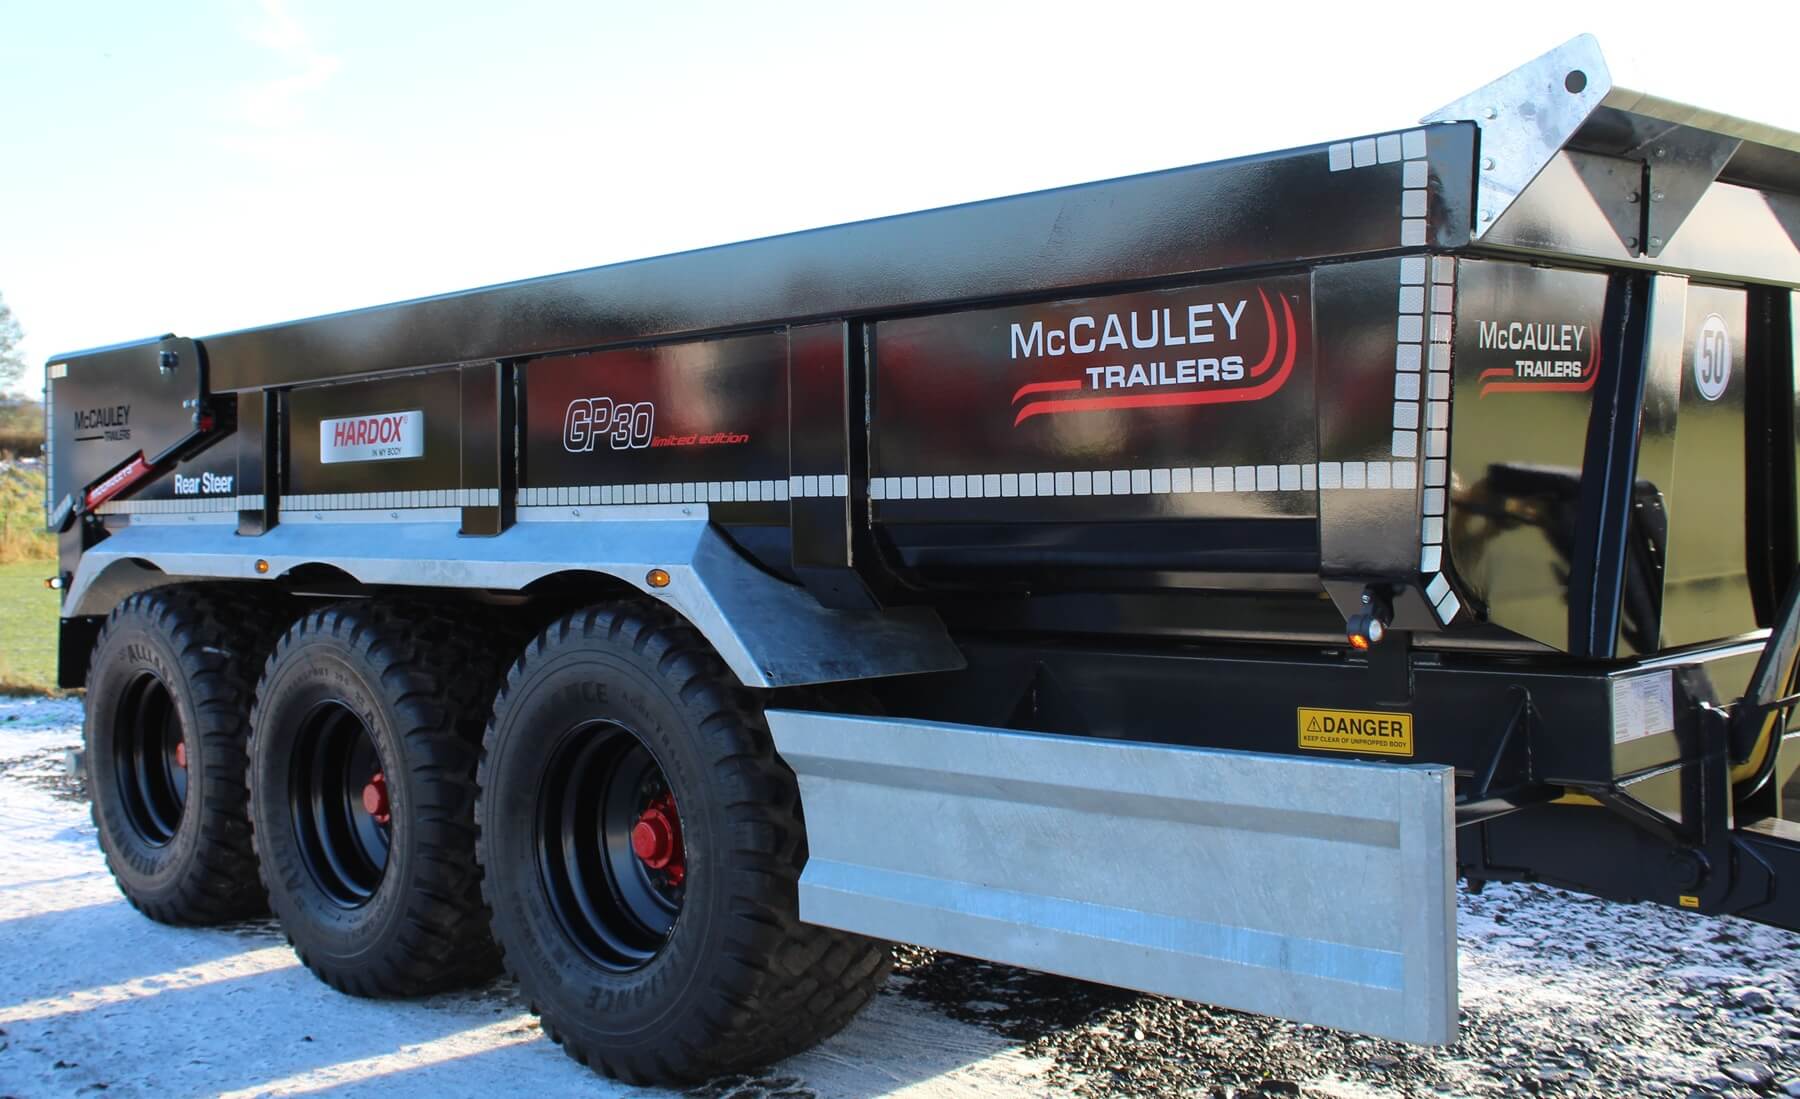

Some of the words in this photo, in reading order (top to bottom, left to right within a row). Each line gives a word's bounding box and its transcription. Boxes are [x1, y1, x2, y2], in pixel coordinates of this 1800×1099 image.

[1010, 299, 1248, 359] McCAULEY
[1478, 320, 1586, 352] McCAULEY
[1515, 360, 1582, 378] TRAILERS
[1701, 329, 1726, 385] 50
[1086, 355, 1245, 390] TRAILERS
[74, 404, 131, 430] McCAULEY
[333, 415, 404, 447] HARDOX
[563, 396, 655, 452] GP30
[650, 433, 697, 448] limited
[698, 430, 749, 446] edition
[387, 447, 402, 456] BODY
[174, 473, 201, 495] Rear
[202, 471, 234, 493] Steer
[1320, 735, 1340, 743] CLEAR
[1323, 716, 1404, 738] DANGER
